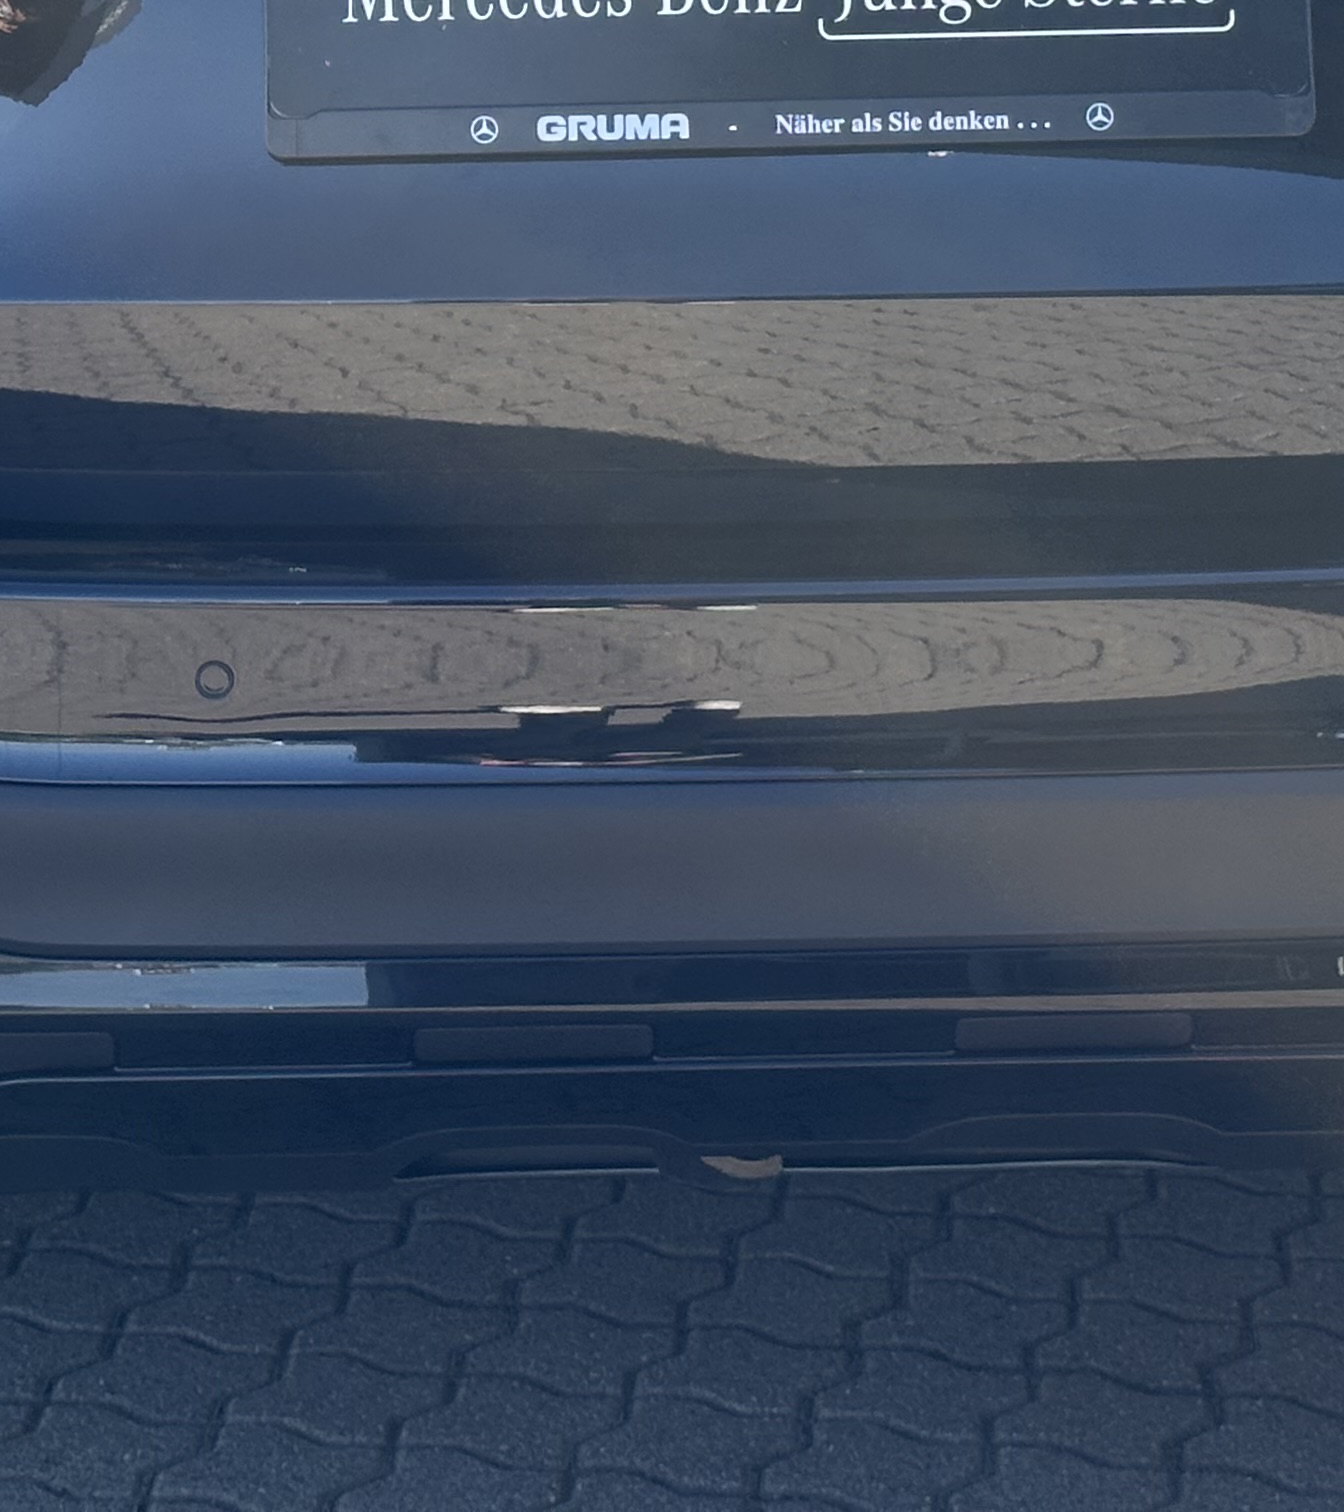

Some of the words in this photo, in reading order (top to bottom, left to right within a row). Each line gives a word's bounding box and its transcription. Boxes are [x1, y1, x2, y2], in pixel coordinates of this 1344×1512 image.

[535, 111, 692, 144] GRUMA
[774, 112, 847, 136] Näher
[850, 112, 884, 135] als
[887, 110, 924, 133] Sie
